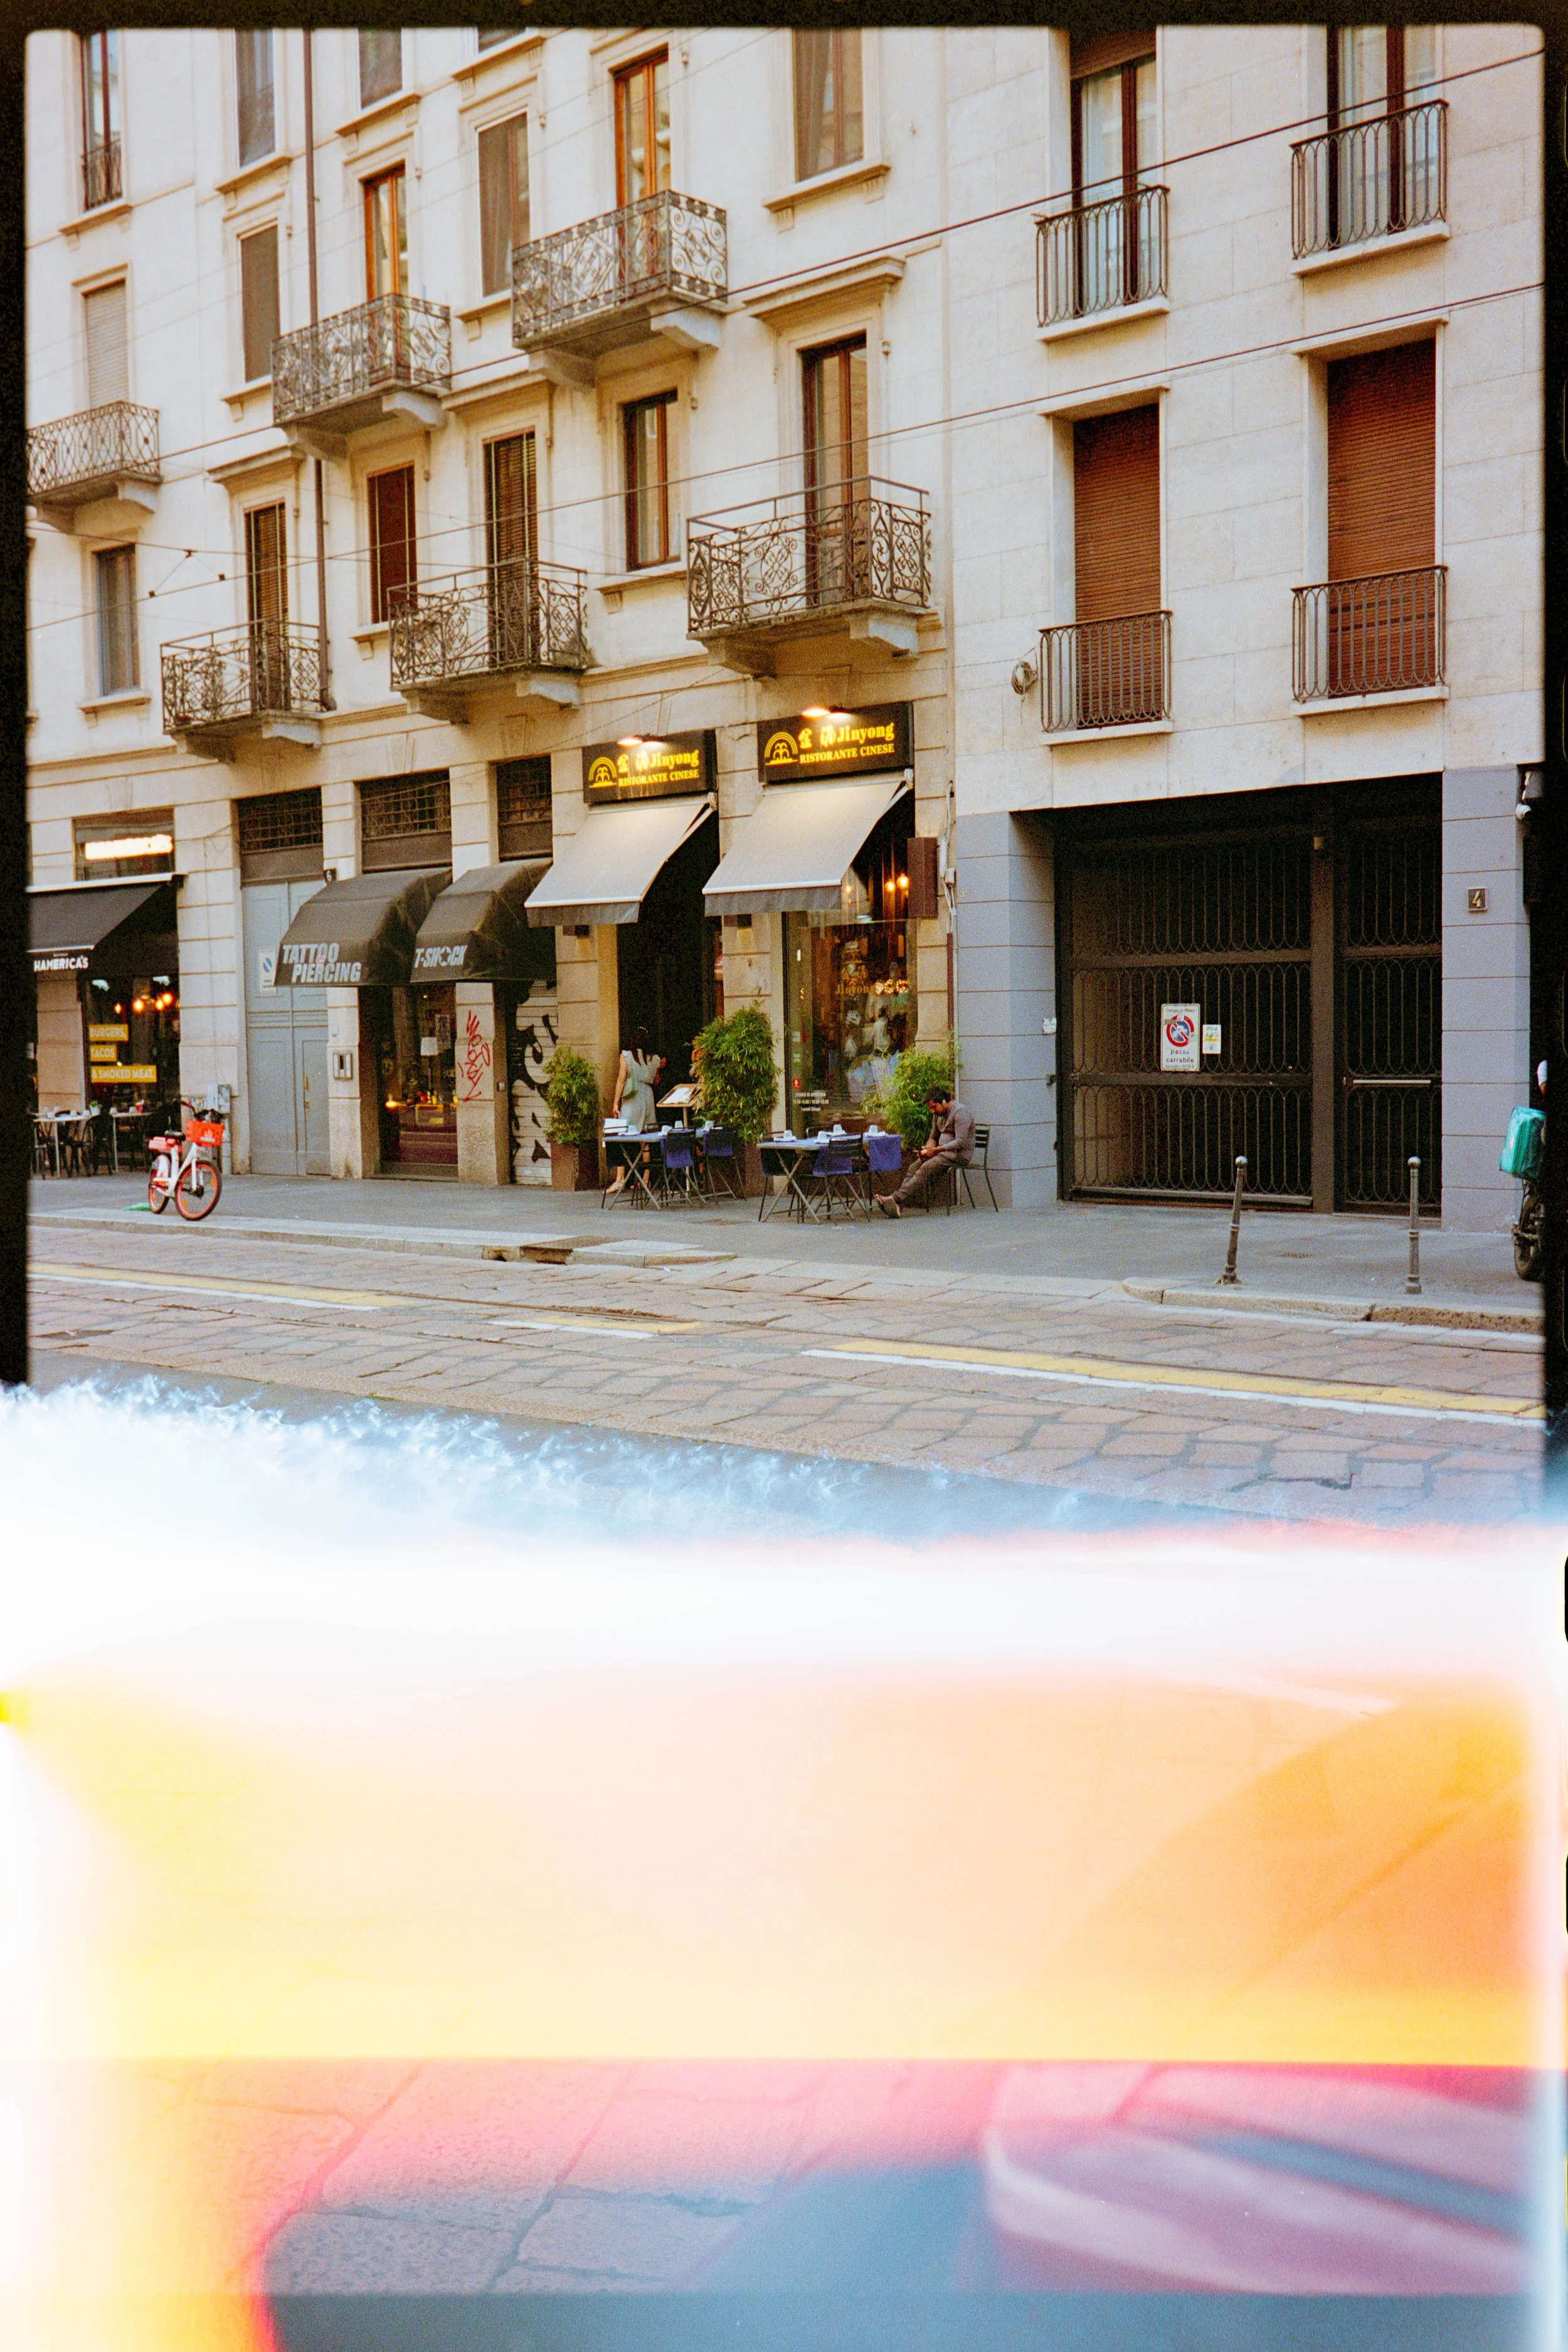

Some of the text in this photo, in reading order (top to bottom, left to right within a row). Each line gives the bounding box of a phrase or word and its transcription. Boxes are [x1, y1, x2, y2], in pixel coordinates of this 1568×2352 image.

[837, 722, 894, 744] Jinyong
[650, 750, 699, 770] Jinyong
[800, 743, 894, 763] RISTORANTE CINESE
[618, 769, 699, 787] RISTORANTE CINESE
[1472, 889, 1481, 908] 4
[282, 942, 339, 964] TATTOO
[34, 955, 89, 972] HAMERICA'S
[291, 961, 362, 983] PIERCING
[90, 1047, 115, 1057] TACOS
[98, 1068, 130, 1079] SMOKED
